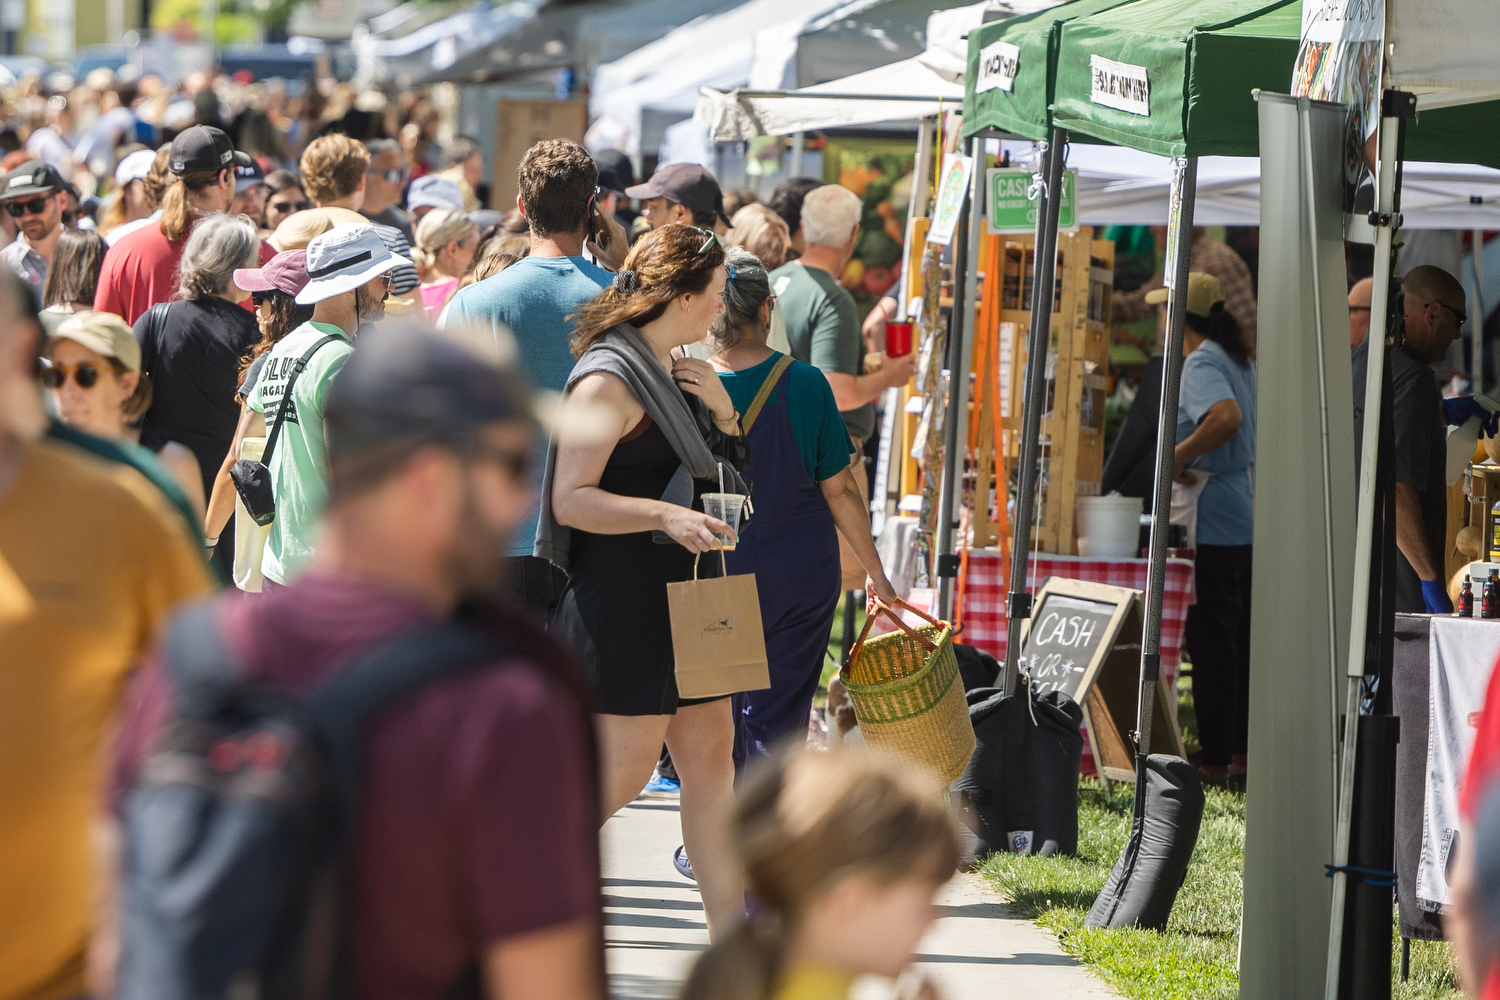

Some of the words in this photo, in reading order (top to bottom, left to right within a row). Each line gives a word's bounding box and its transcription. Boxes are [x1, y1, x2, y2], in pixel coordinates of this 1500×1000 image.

[998, 199, 1007, 209] NO
[1035, 611, 1097, 648] CASH
[1037, 652, 1062, 678] OR
